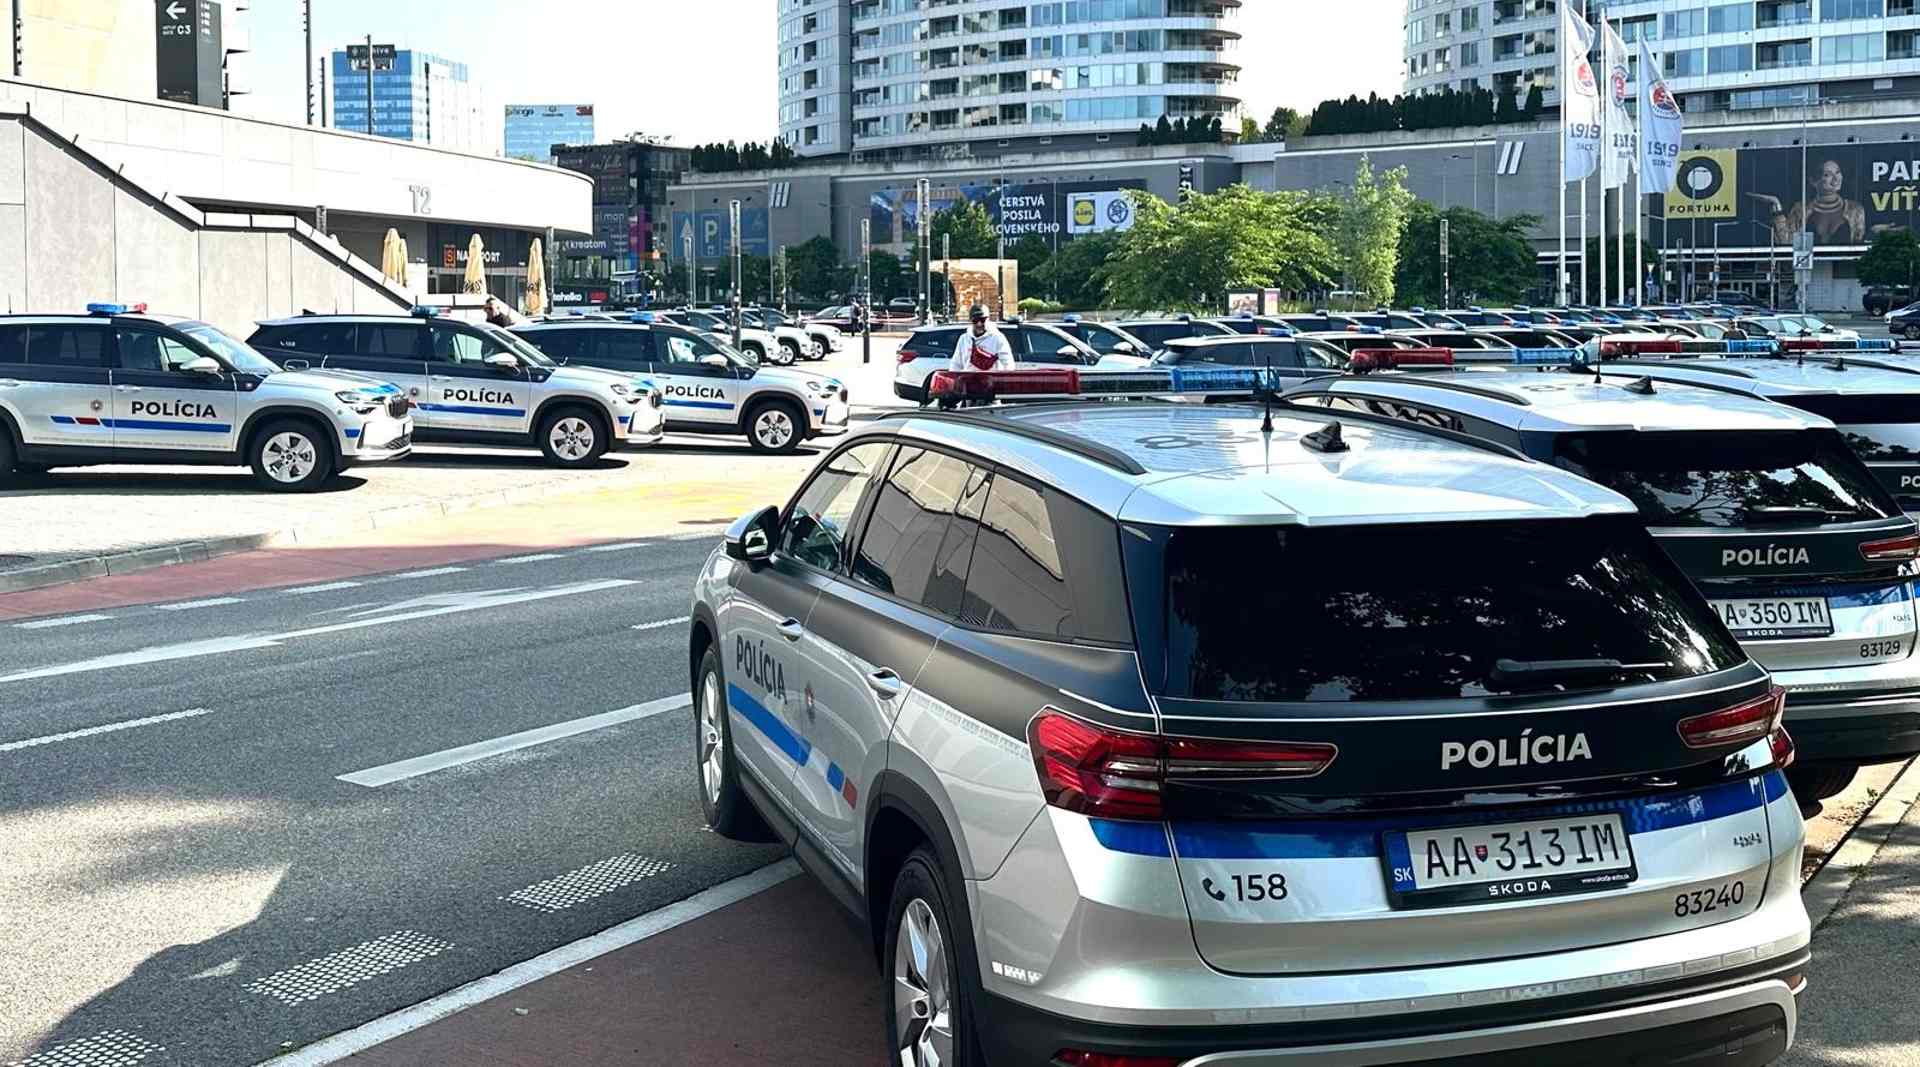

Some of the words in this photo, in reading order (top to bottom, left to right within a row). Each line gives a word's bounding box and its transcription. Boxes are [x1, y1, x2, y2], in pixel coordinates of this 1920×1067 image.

[1569, 123, 1601, 139] 1919
[408, 184, 432, 215] T2
[1002, 209, 1041, 221] POSILA
[1669, 204, 1730, 214] FORTUNA
[444, 387, 514, 405] POLÍCIA
[665, 384, 725, 400] POLÍCIA
[131, 400, 217, 418] POLÍCIA
[1722, 544, 1810, 566] POLÍCIA
[1860, 640, 1900, 658] 83129
[736, 634, 788, 705] POLÍCIA
[1441, 728, 1593, 770] POLÍCIA
[1393, 867, 1413, 883] SK
[1231, 873, 1288, 902] 158
[1674, 881, 1744, 917] 83240
